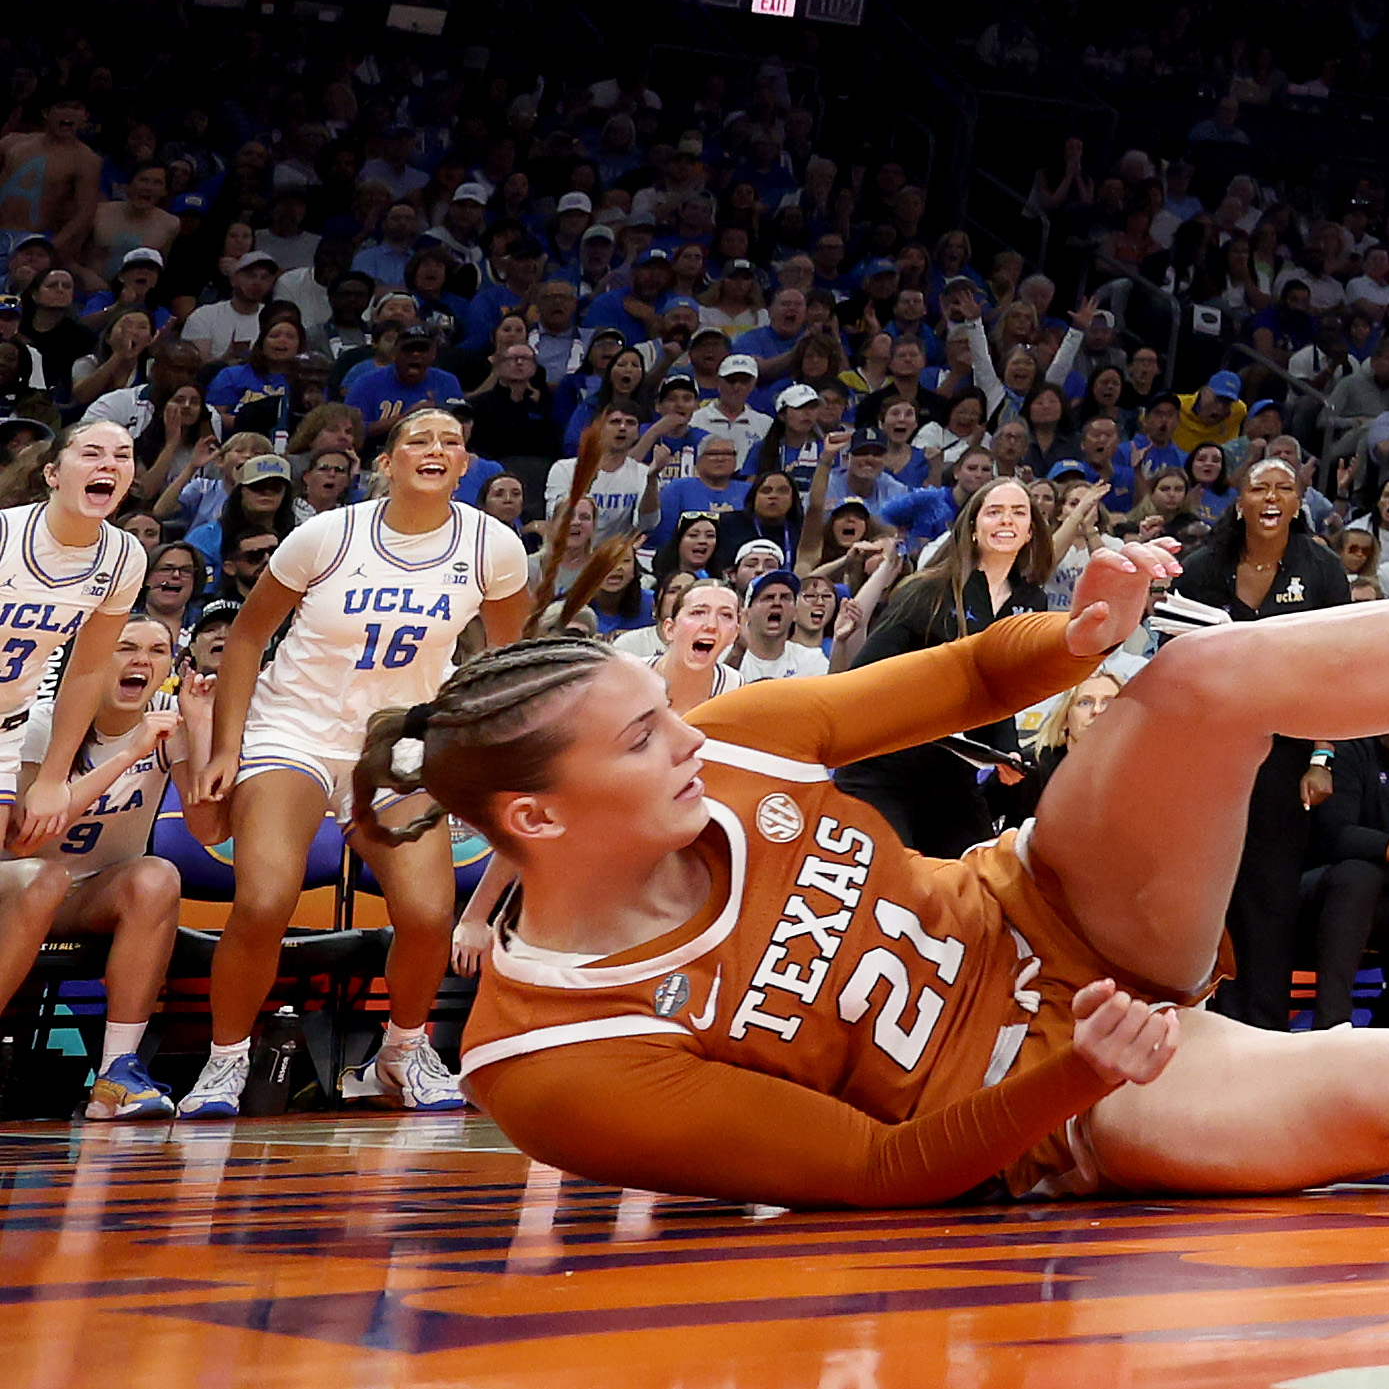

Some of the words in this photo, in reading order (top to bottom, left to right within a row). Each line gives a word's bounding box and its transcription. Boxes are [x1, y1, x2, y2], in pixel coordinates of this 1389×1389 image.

[343, 586, 452, 621] UCLA
[354, 622, 428, 671] 16
[60, 822, 104, 854] 9
[760, 795, 801, 842] SEC
[728, 814, 875, 1043] TEXAS
[837, 898, 966, 1072] 21
